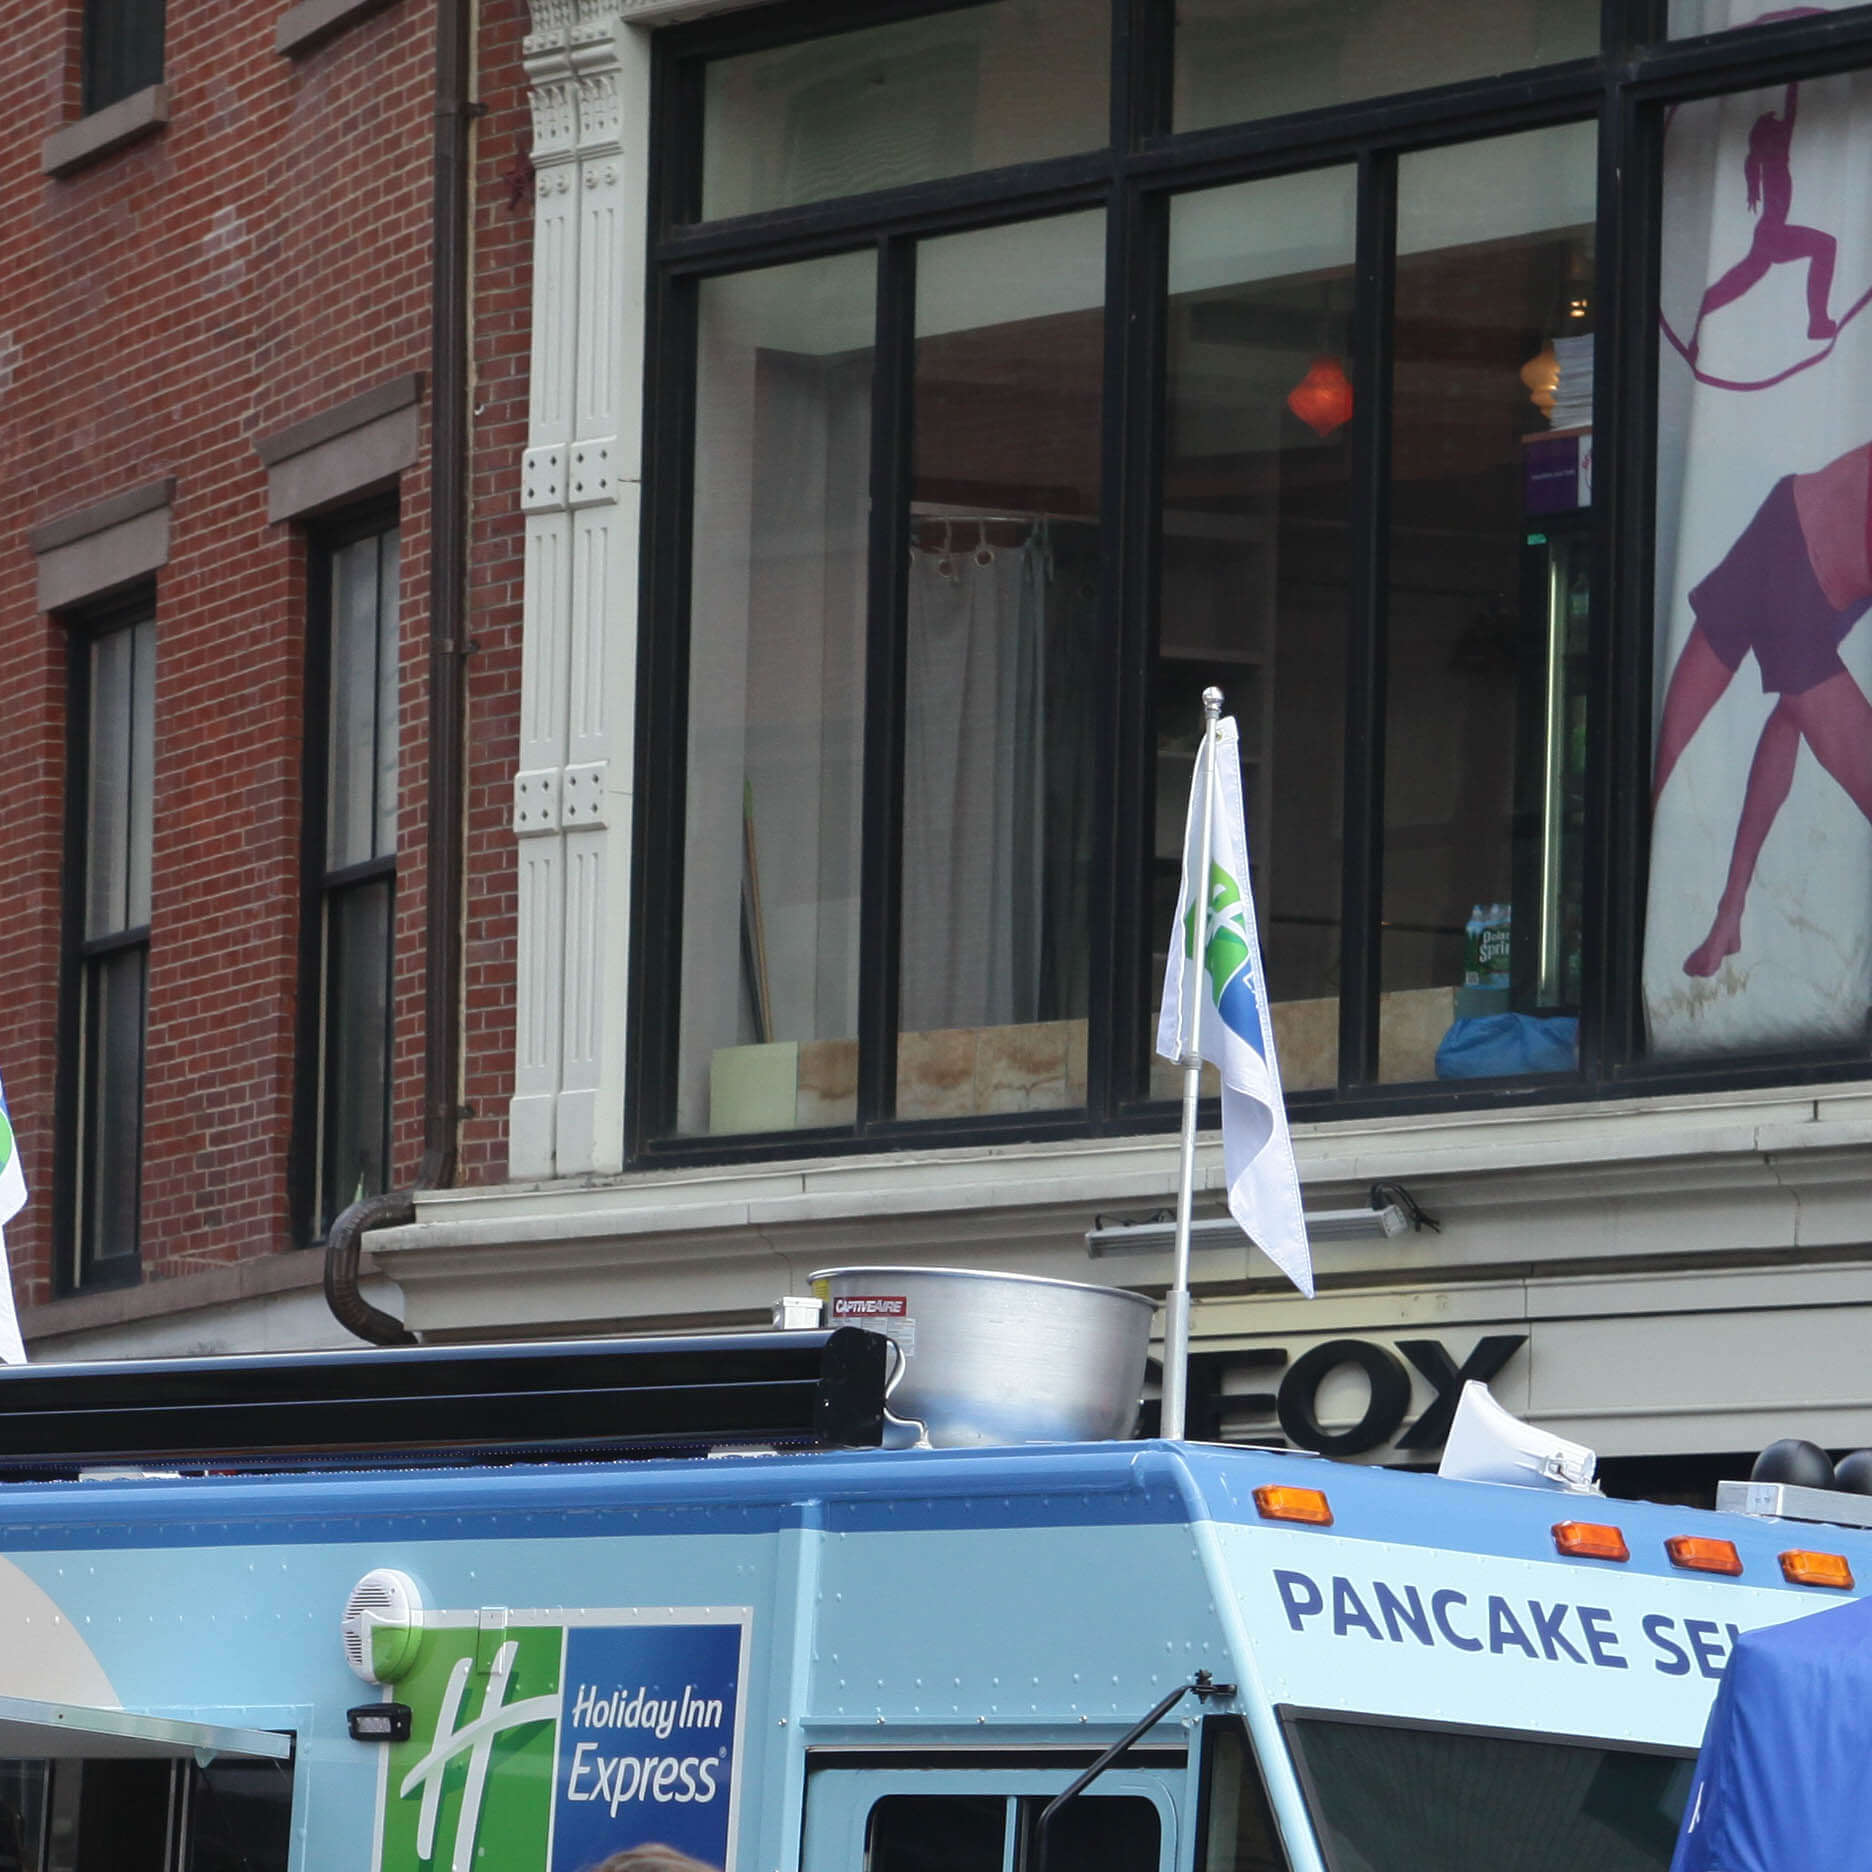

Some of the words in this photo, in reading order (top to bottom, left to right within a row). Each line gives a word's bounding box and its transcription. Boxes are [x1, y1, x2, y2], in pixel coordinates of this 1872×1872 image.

[1272, 1568, 1628, 1670] PANCAKE
[571, 1683, 677, 1740] Holiday
[677, 1685, 724, 1729] Inn
[566, 1742, 721, 1819] Express
